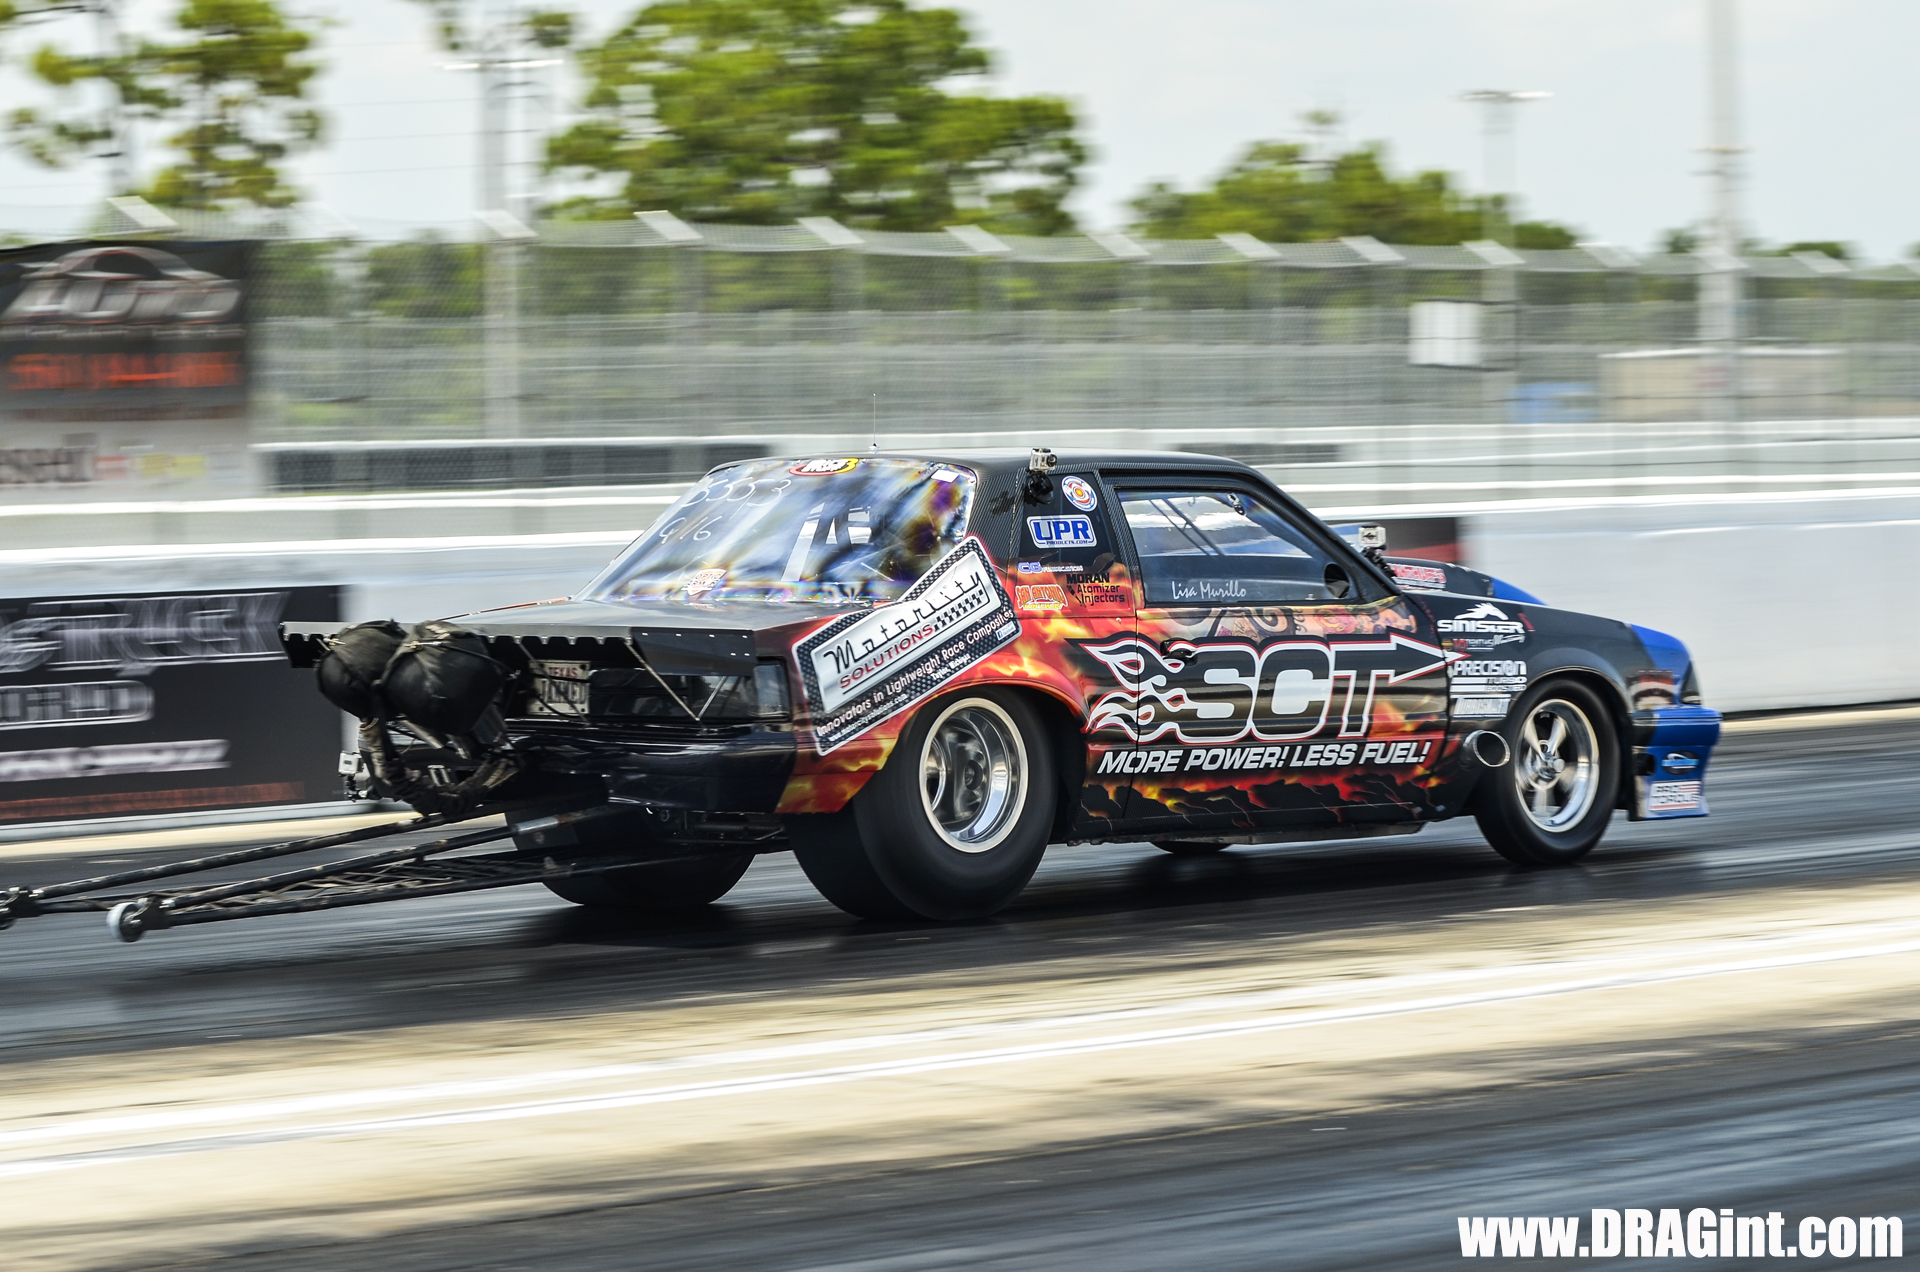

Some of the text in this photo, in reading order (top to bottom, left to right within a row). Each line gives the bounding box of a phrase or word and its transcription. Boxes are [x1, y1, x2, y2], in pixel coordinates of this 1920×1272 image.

[1033, 520, 1092, 540] UPR
[1066, 573, 1110, 584] MORAN
[1077, 584, 1120, 594] Atomizer
[1172, 580, 1247, 599] Lisa Murillo
[1081, 594, 1125, 606] Injectors
[840, 623, 934, 689] SOLUTIONS
[816, 698, 872, 737] Innovators
[873, 691, 885, 703] in
[886, 653, 941, 695] Lightweight
[941, 640, 966, 661] Race
[966, 606, 1014, 644] Composites
[1168, 634, 1467, 744] SCT
[1097, 741, 1432, 775] MORE POWER! LESS FUEL!
